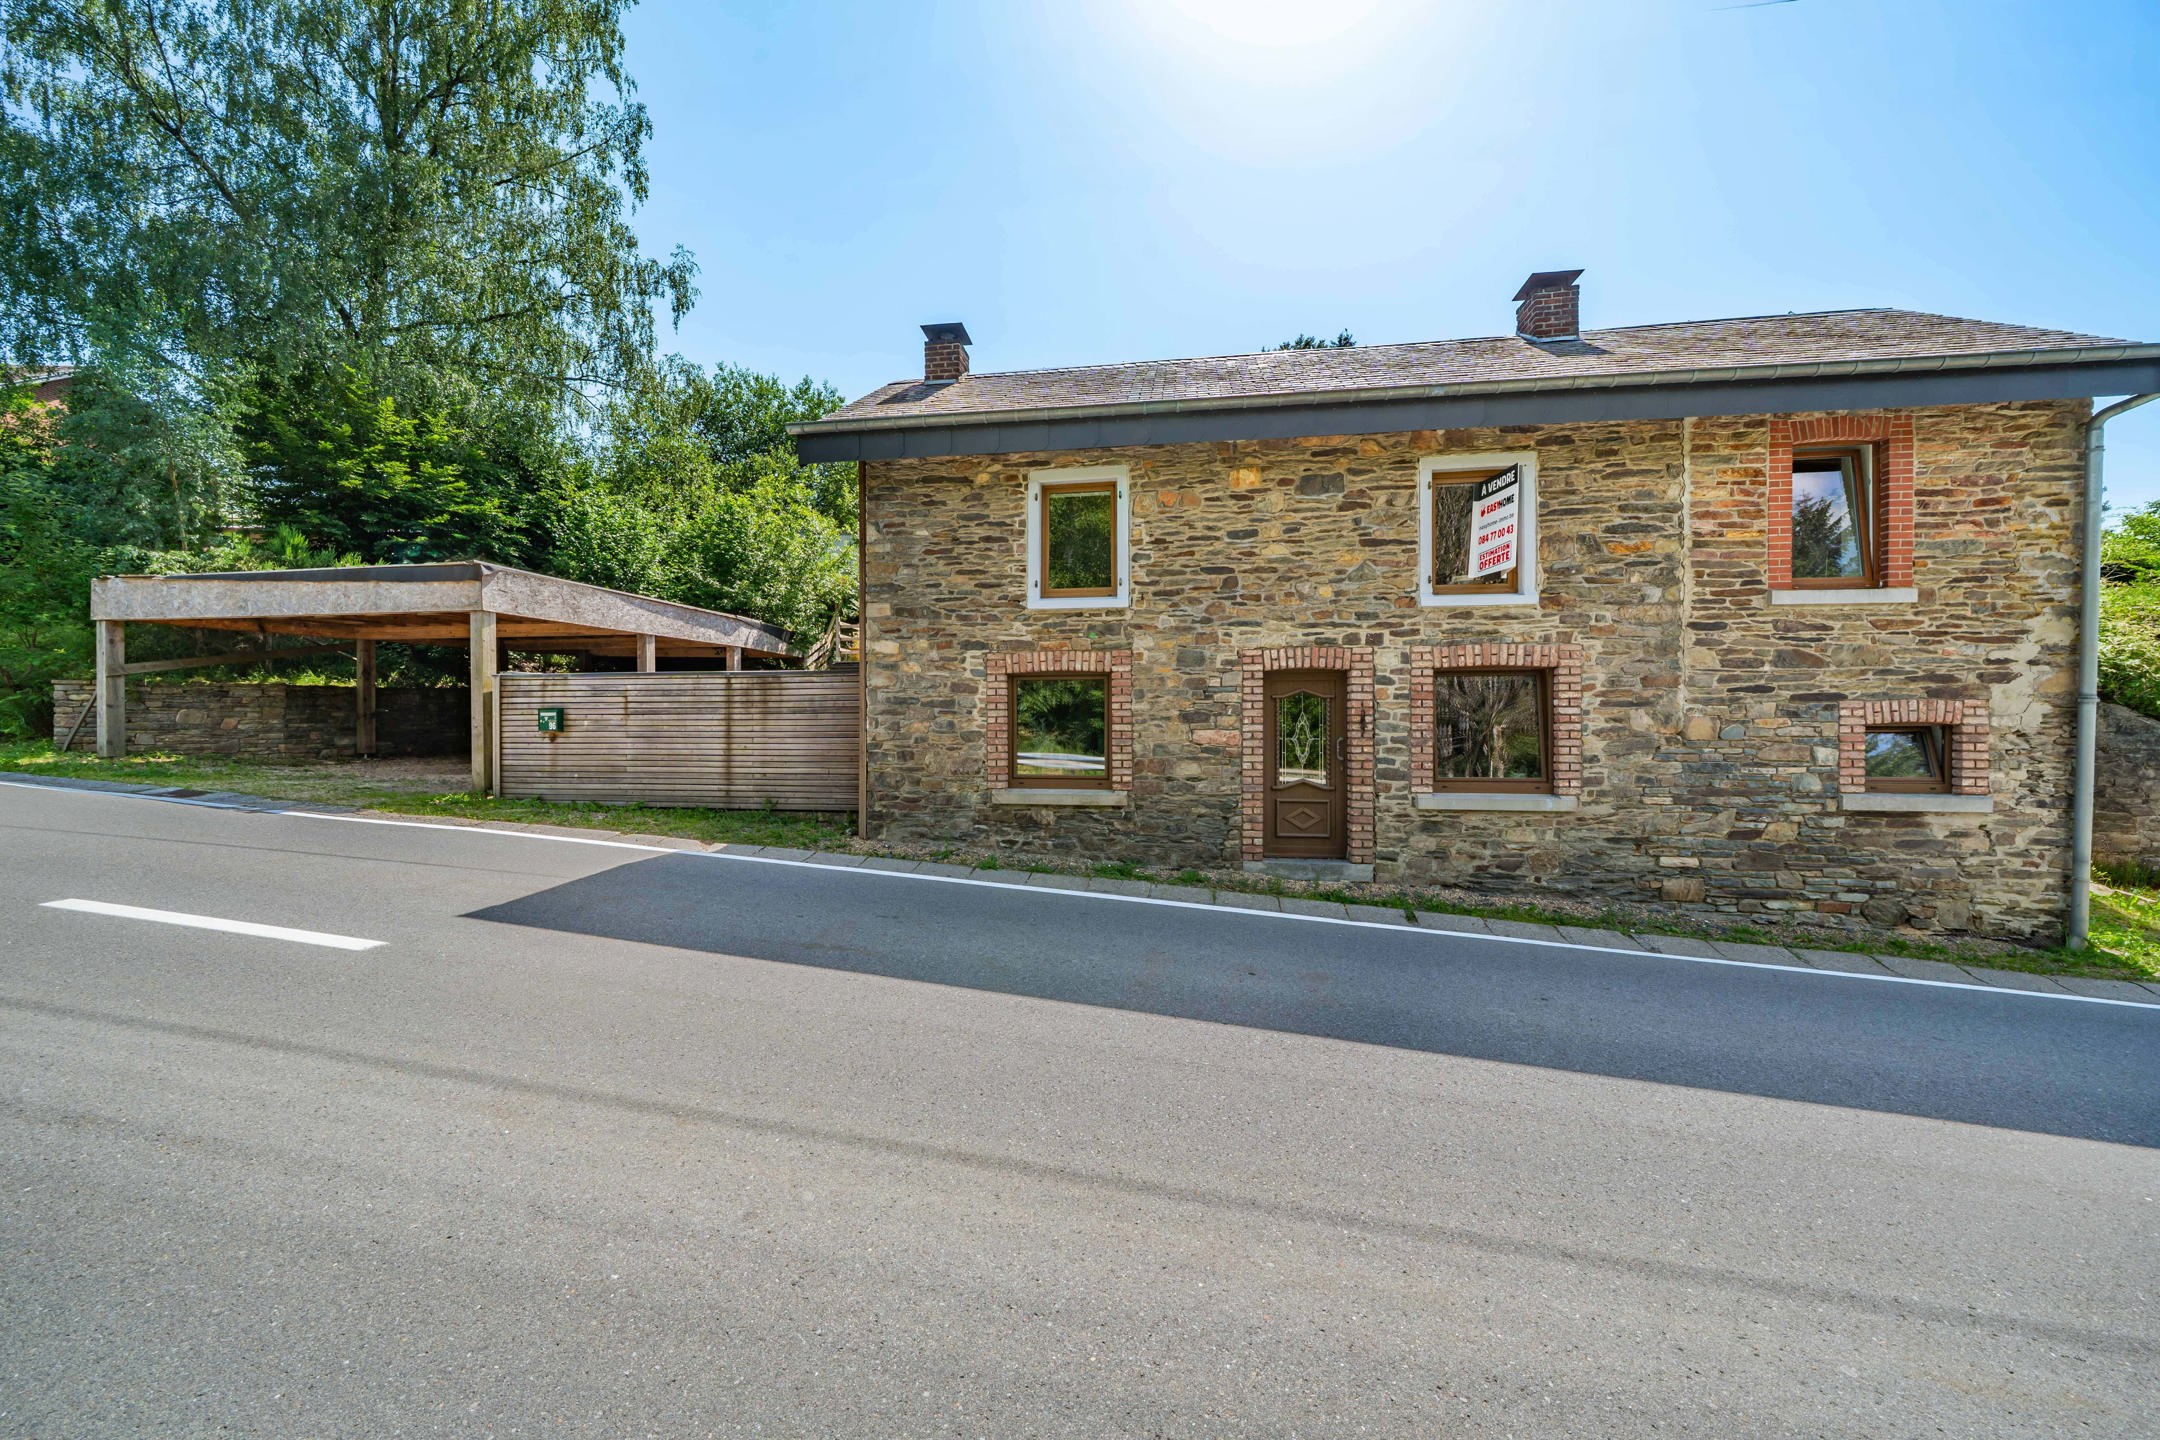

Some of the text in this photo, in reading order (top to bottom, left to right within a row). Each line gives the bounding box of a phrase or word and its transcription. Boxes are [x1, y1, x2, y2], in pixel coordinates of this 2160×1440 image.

[1488, 470, 1516, 493] VENDRE
[1478, 524, 1514, 545] 084 77 00 43
[1479, 543, 1510, 561] ESTIMATION
[1479, 550, 1510, 570] OFFERTE
